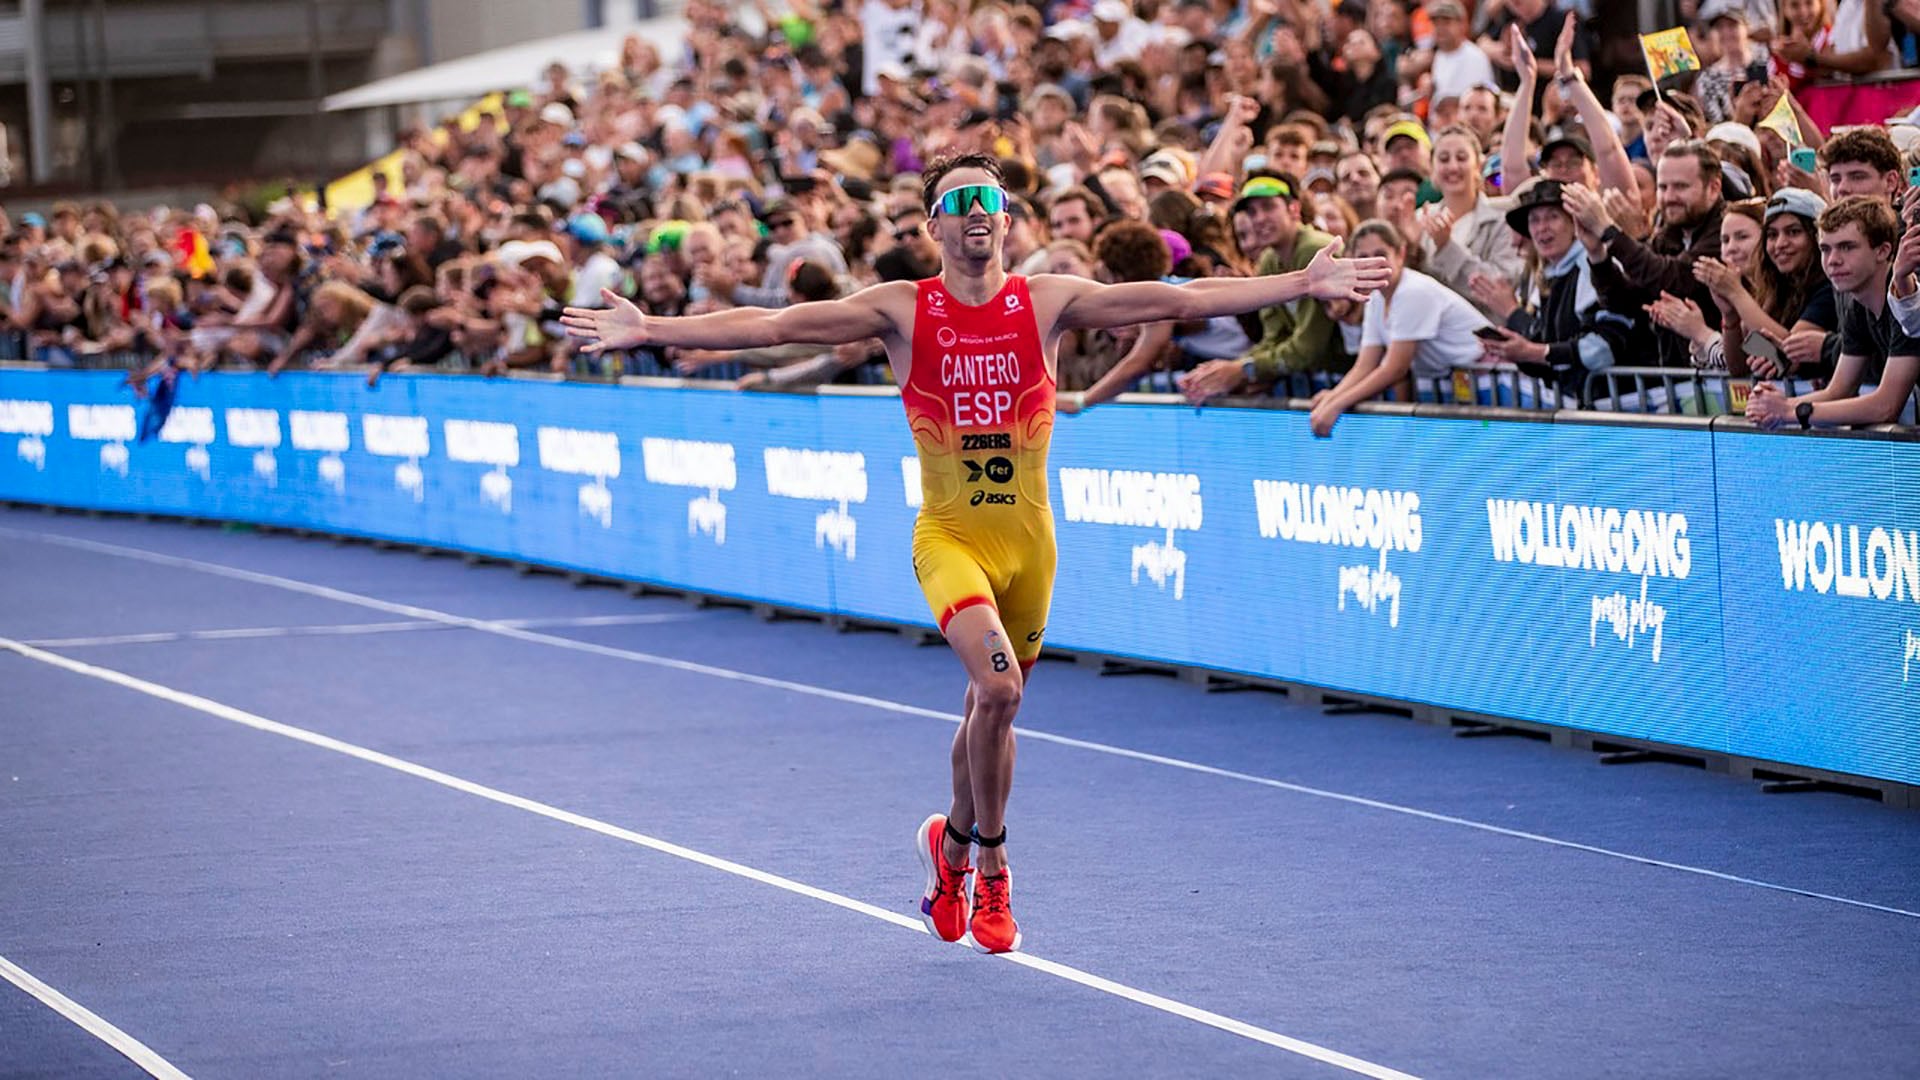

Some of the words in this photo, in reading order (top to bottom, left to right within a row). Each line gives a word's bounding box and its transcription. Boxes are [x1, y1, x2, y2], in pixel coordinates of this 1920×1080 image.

[941, 351, 1020, 386] CANTERO
[954, 391, 1011, 426] ESP
[961, 433, 1011, 450] 226ERS
[989, 464, 1009, 475] Fer
[985, 493, 1016, 505] asics
[1253, 479, 1422, 552] WOLLONGONG
[1487, 498, 1691, 579] WOLLONGONG
[1775, 518, 1920, 602] WOLLON
[991, 652, 1010, 672] 8
